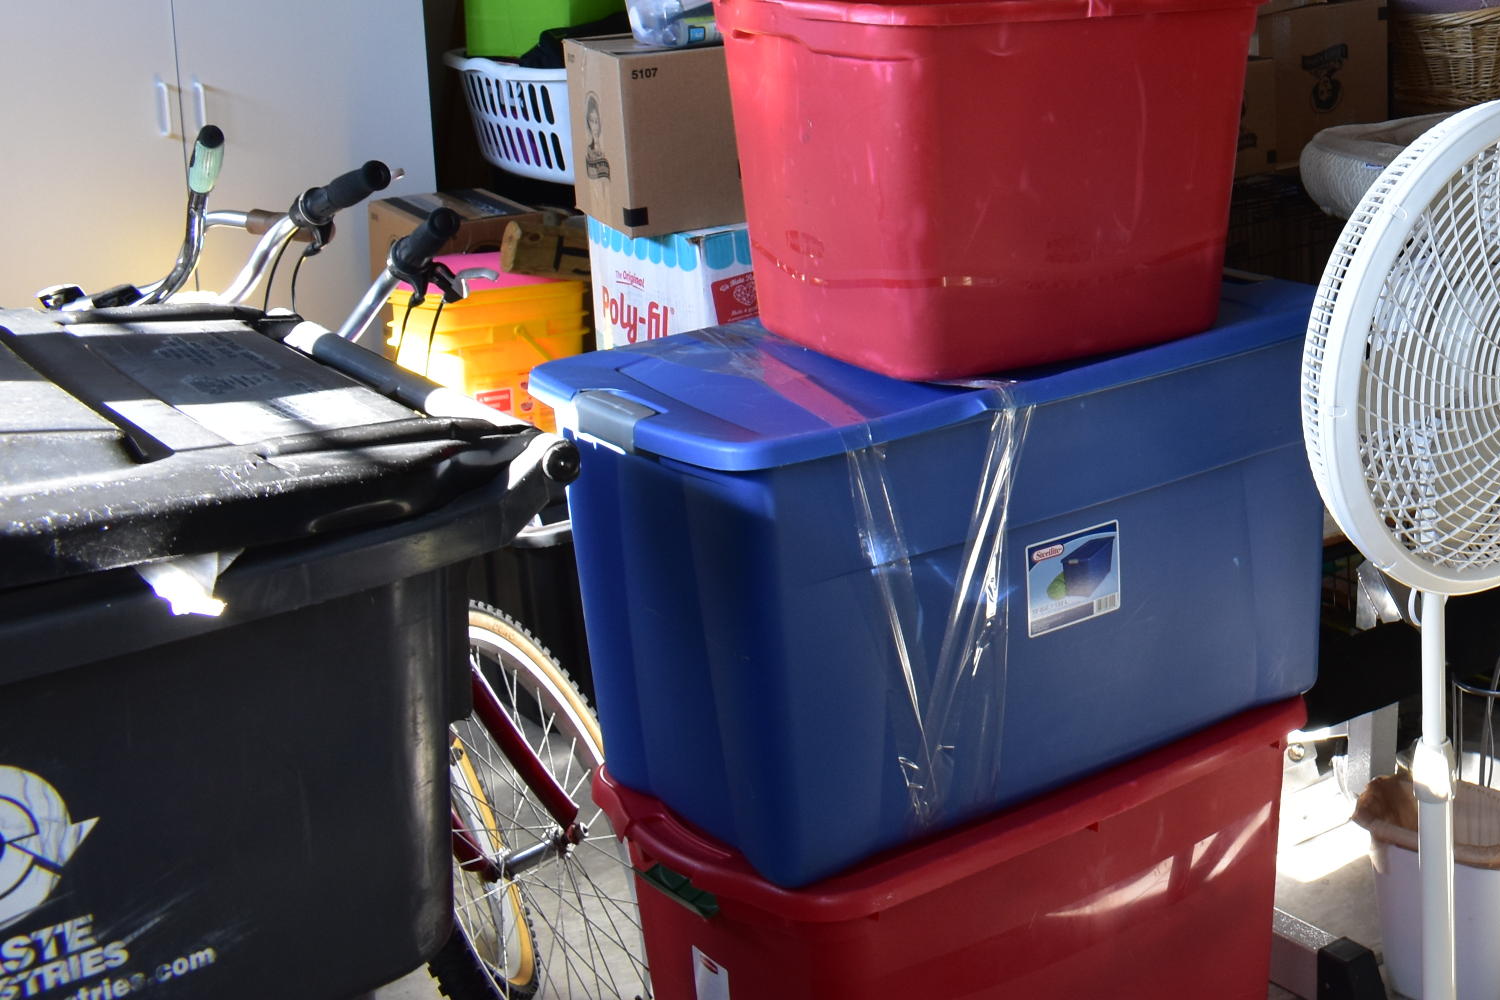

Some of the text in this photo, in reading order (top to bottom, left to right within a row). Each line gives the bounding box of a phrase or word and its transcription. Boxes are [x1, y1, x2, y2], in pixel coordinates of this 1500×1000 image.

[631, 67, 658, 80] 5107
[622, 269, 645, 288] Original
[0, 913, 97, 975] STE
[64, 947, 218, 1000] tries.com
